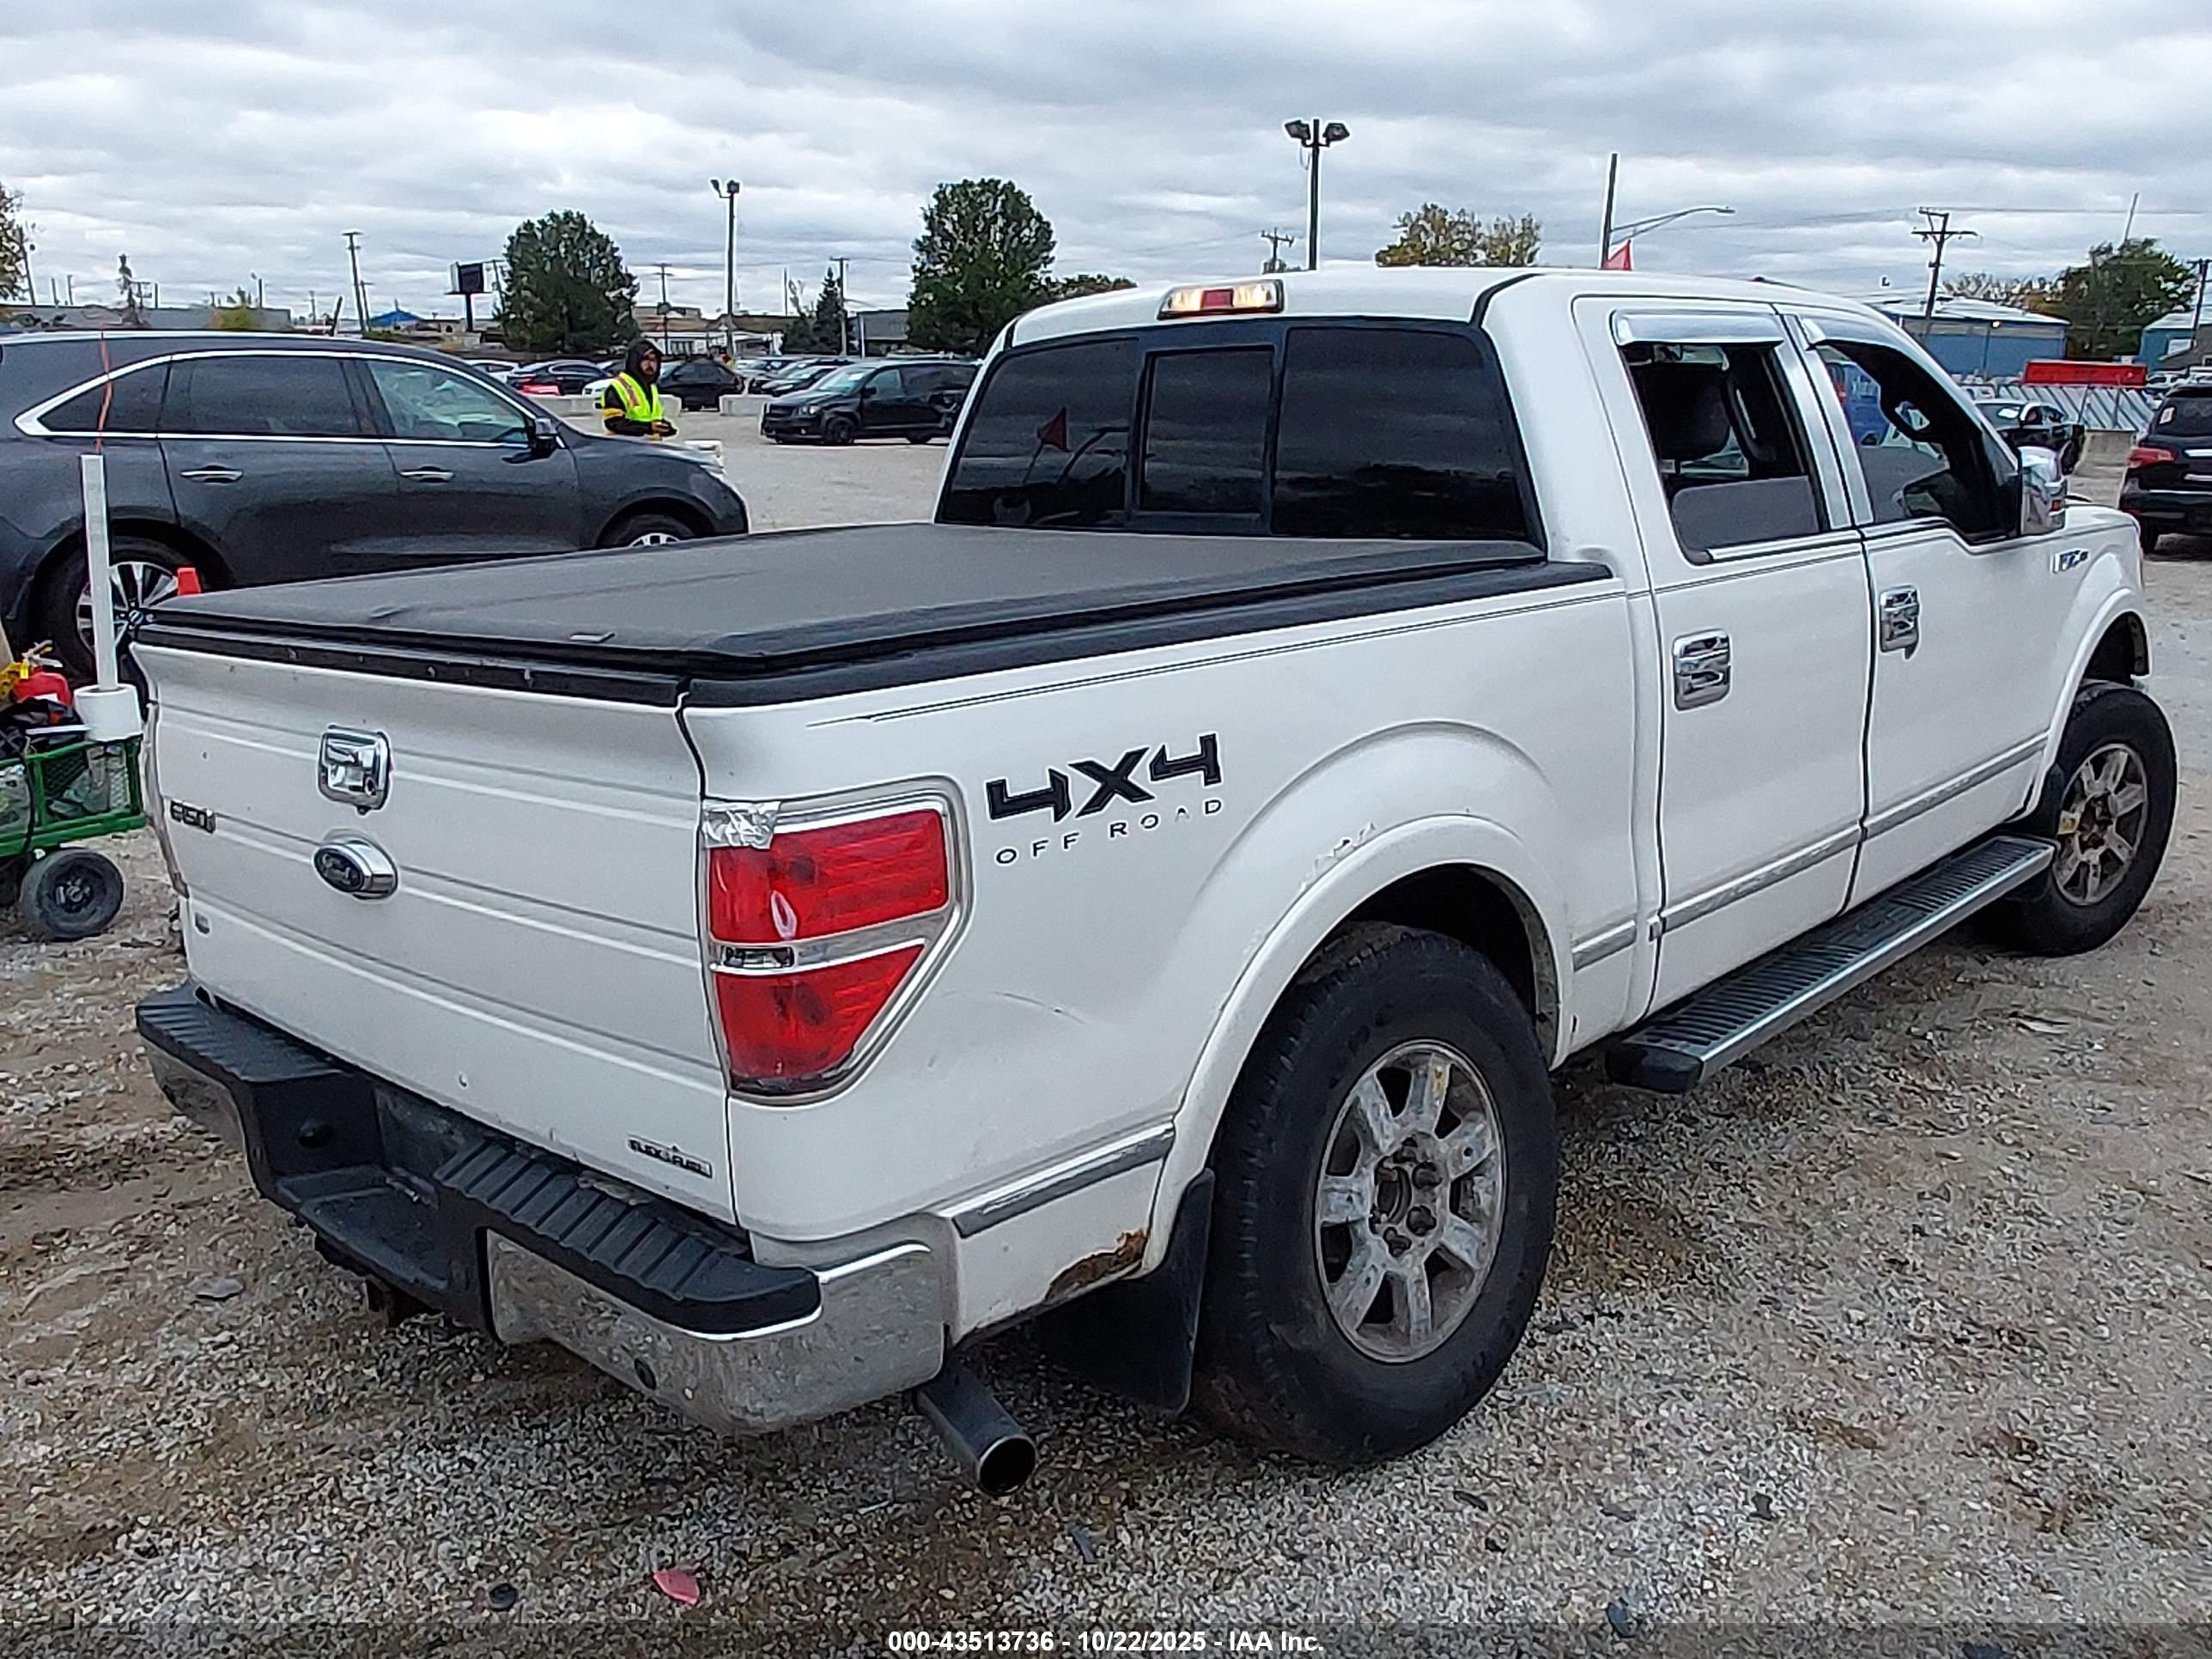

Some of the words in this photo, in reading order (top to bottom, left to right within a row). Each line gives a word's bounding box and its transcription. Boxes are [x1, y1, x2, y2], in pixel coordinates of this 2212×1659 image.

[986, 733, 1221, 822] 4X4
[995, 831, 1080, 865] OFF
[1109, 799, 1222, 838] ROAD
